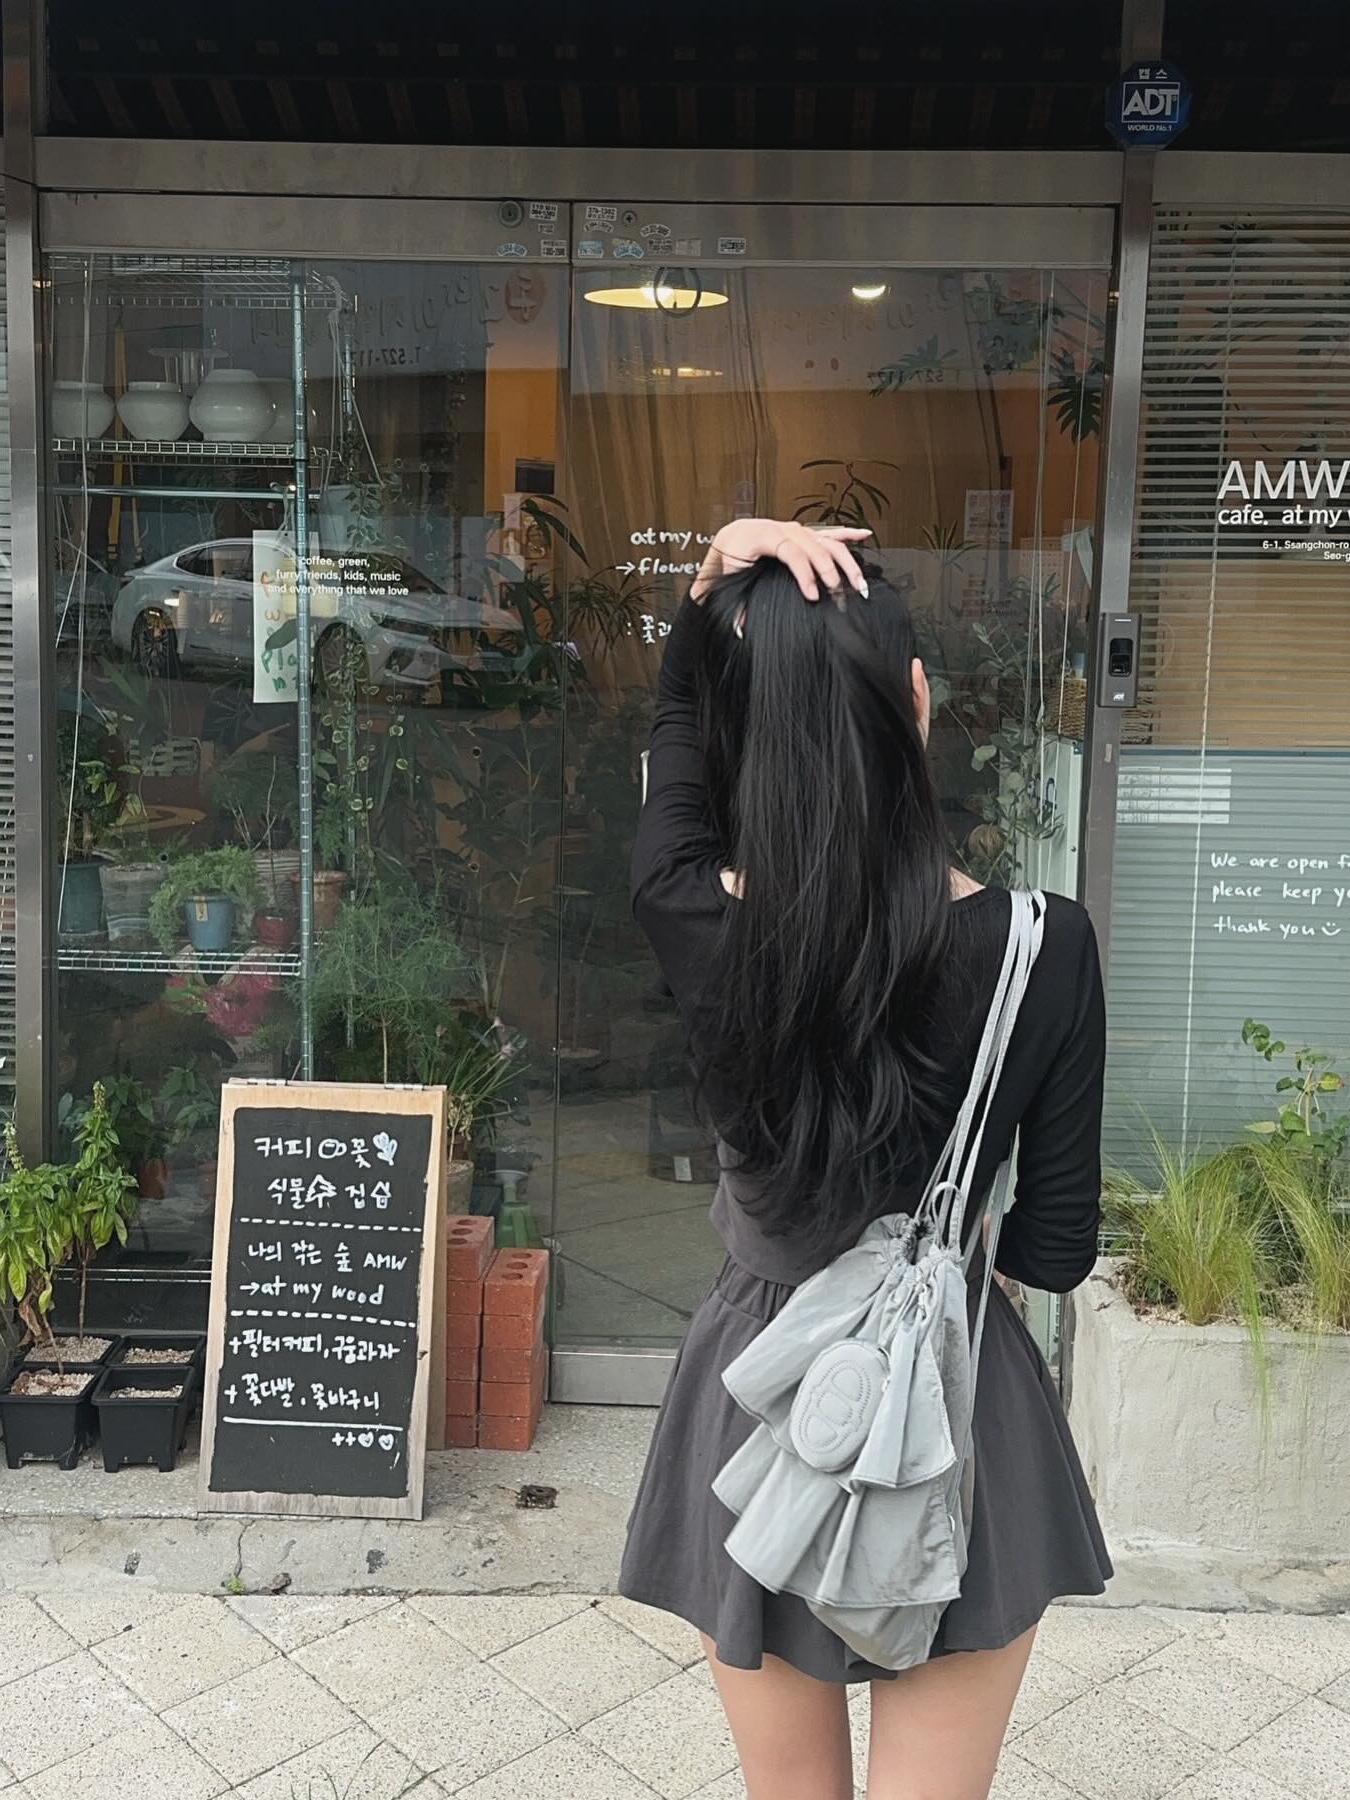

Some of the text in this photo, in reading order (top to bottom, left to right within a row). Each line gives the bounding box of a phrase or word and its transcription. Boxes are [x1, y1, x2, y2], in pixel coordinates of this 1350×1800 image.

[1139, 68, 1168, 80] 캡스
[1122, 88, 1179, 116] ADT
[1127, 124, 1156, 132] WORLD
[1217, 460, 1350, 499] AMW
[1218, 504, 1268, 526] cafe.
[1281, 504, 1304, 525] at
[1308, 508, 1342, 528] my
[630, 527, 656, 546] at
[659, 531, 692, 551] my
[1284, 540, 1350, 552] Ssangchon-ro
[301, 556, 370, 568] coffee, green,
[276, 569, 402, 582] furry friends, kids, music
[267, 583, 409, 597] and everything that we love
[1211, 852, 1239, 868] We
[1249, 857, 1280, 868] are
[1287, 858, 1328, 875] open
[1212, 880, 1262, 903] please
[1282, 881, 1322, 905] keep
[1213, 915, 1316, 940] thank you
[254, 1136, 372, 1168] 커피 꽃
[267, 1177, 366, 1210] 식물 집
[248, 1239, 408, 1273] 나의 작은 숲 AMW
[260, 1275, 385, 1305] at my wood
